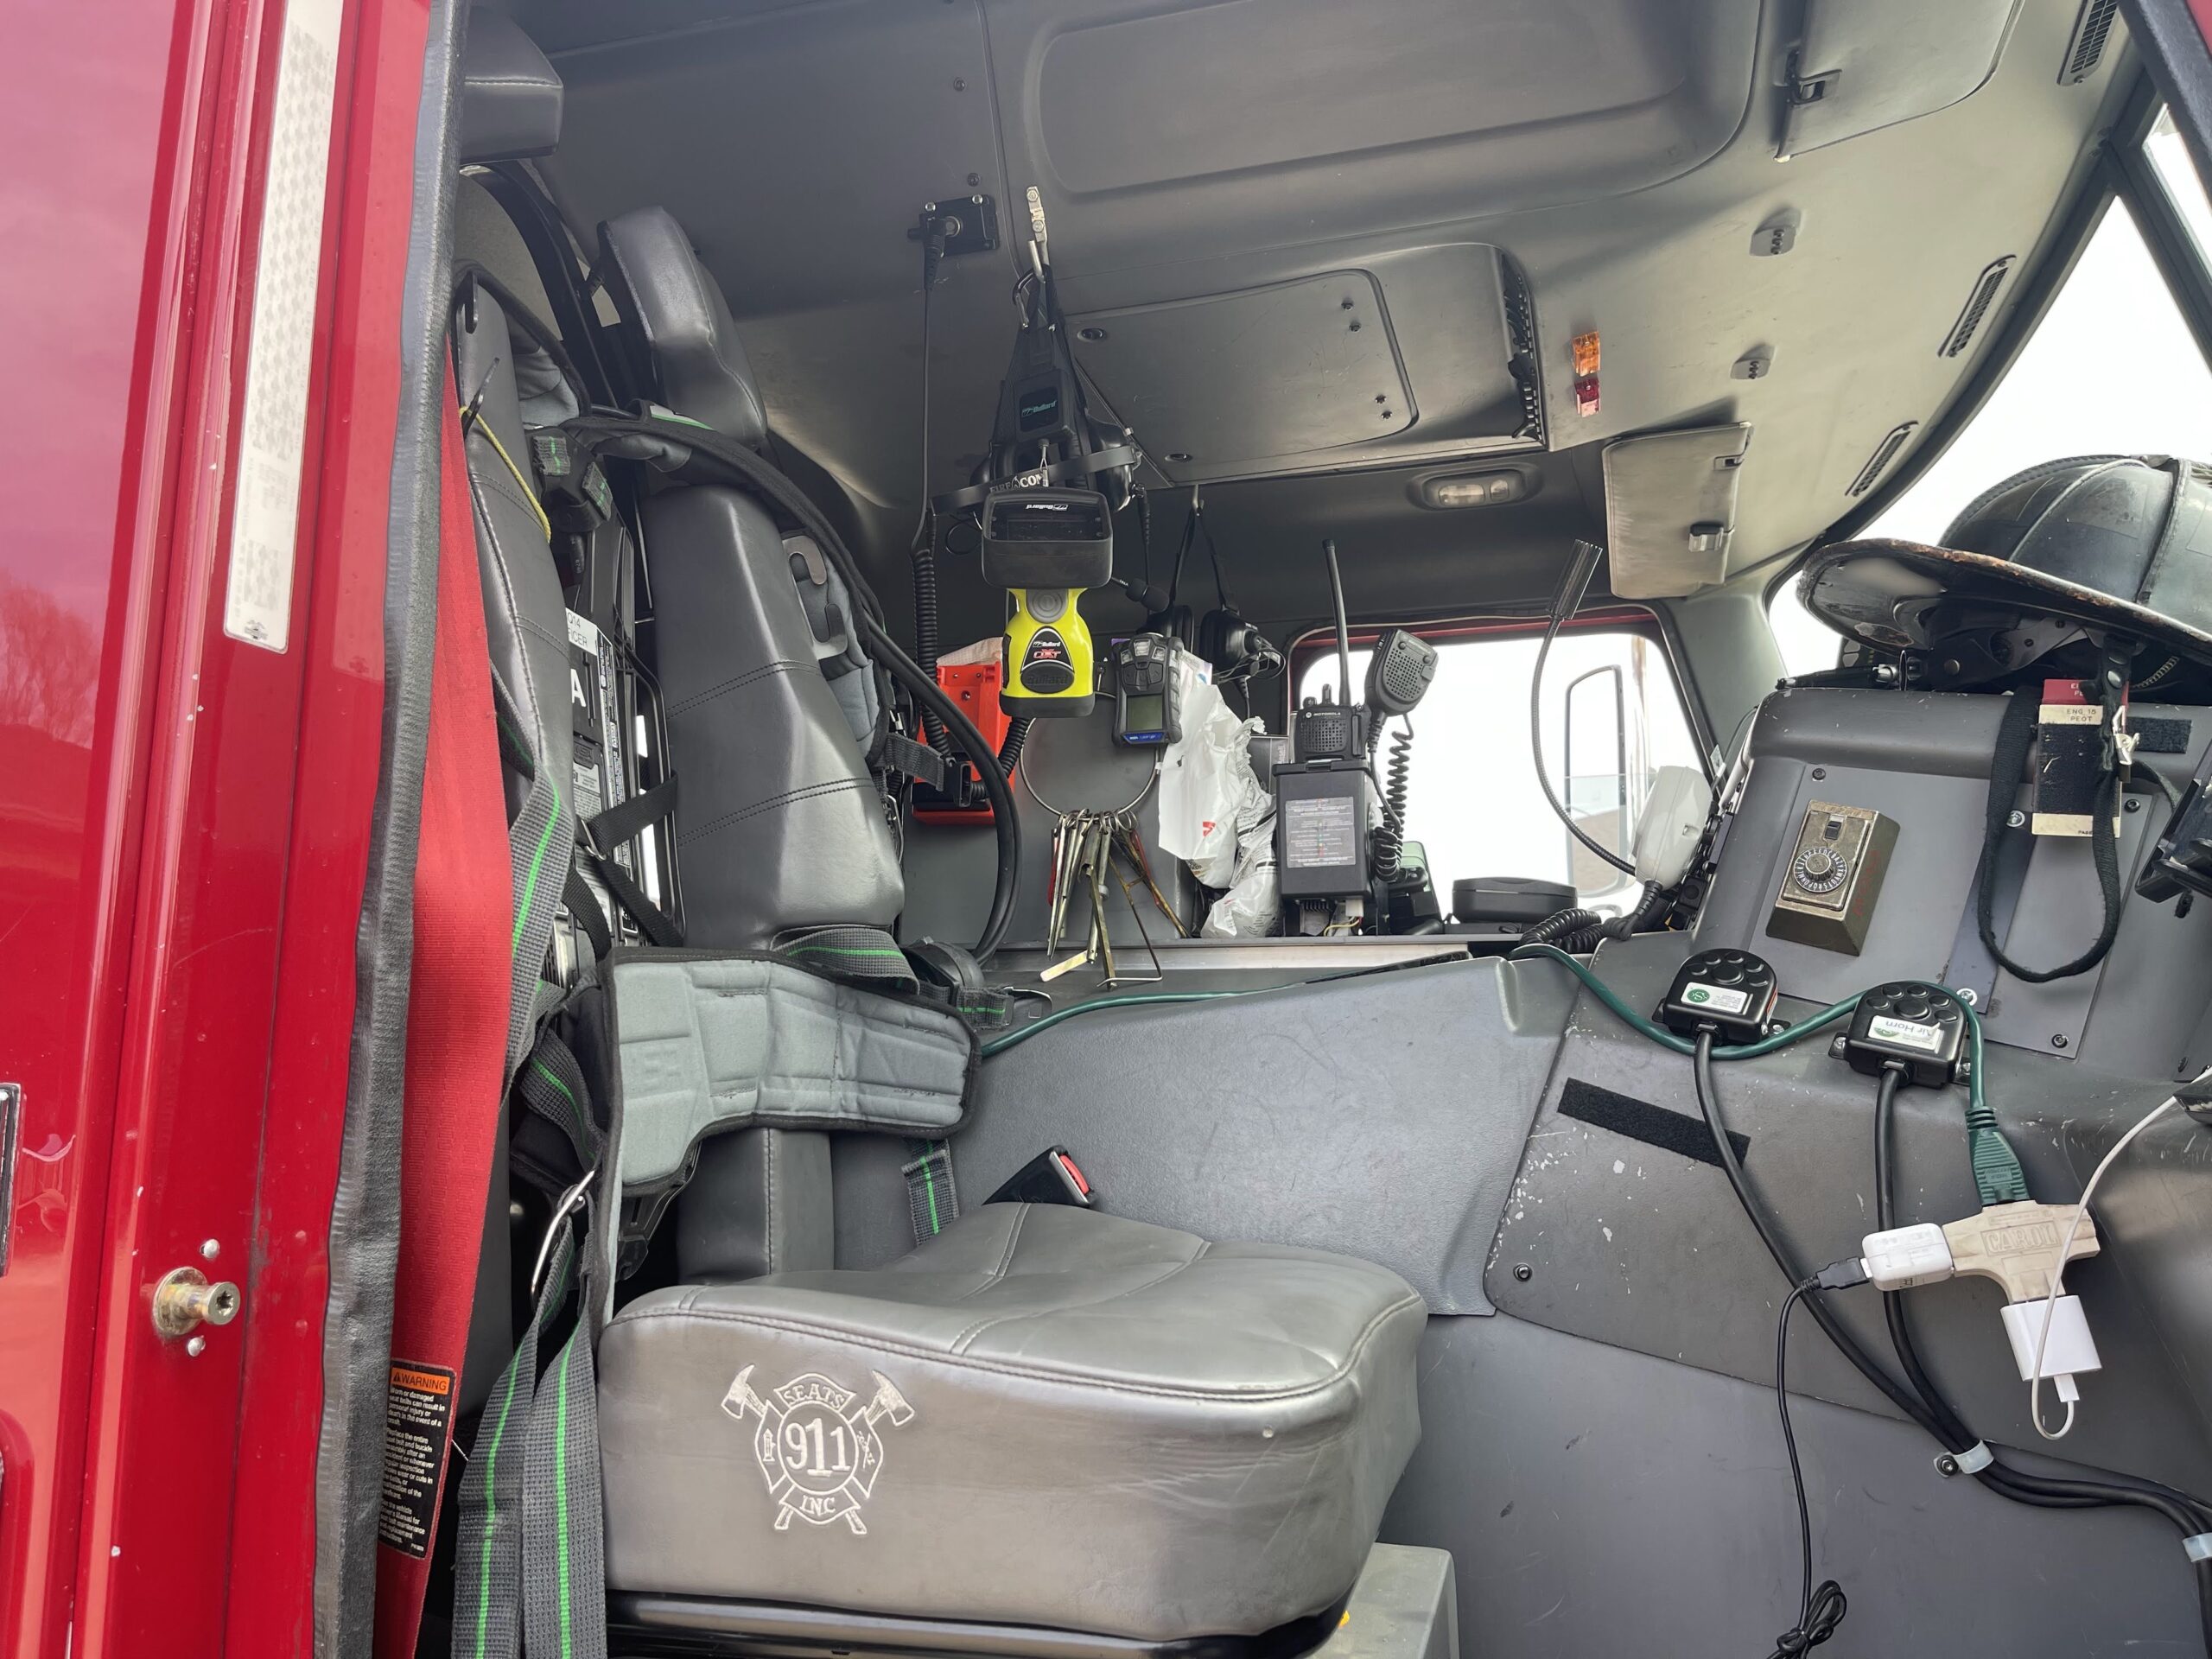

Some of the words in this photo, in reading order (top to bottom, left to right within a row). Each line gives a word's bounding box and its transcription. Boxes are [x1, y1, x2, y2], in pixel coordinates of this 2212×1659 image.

[1033, 399, 1057, 413] Bullard
[1885, 1020, 1915, 1033] Horn
[1987, 1223, 2056, 1253] CAROL
[402, 1372, 447, 1391] WARNING
[410, 1391, 434, 1402] damaged
[784, 1383, 844, 1408] SEATS
[423, 1402, 438, 1411] result
[785, 1417, 851, 1478] 911
[799, 1495, 836, 1516] INC
